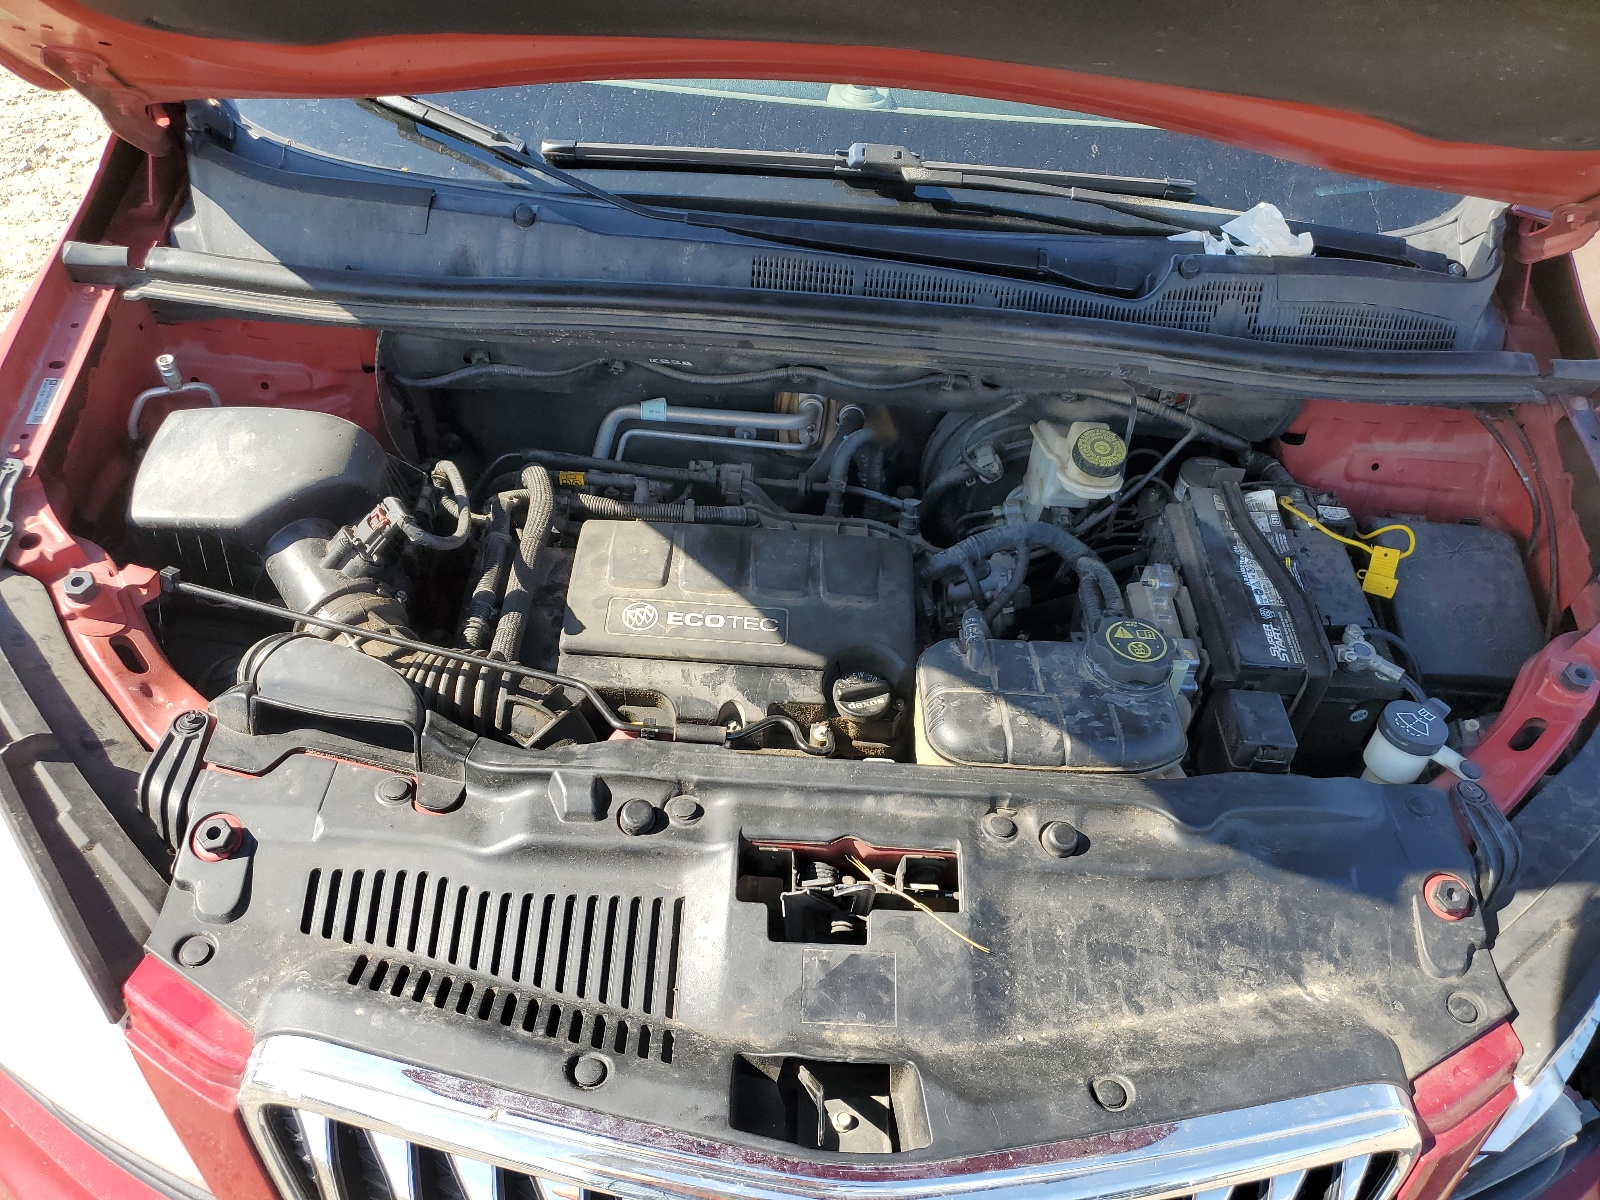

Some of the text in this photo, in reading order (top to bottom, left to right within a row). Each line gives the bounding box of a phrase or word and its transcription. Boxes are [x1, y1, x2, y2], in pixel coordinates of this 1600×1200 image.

[666, 611, 779, 632] ECOTEC
[1262, 623, 1280, 657] SUPER
[1271, 624, 1291, 663] START
[848, 698, 885, 709] dexos
